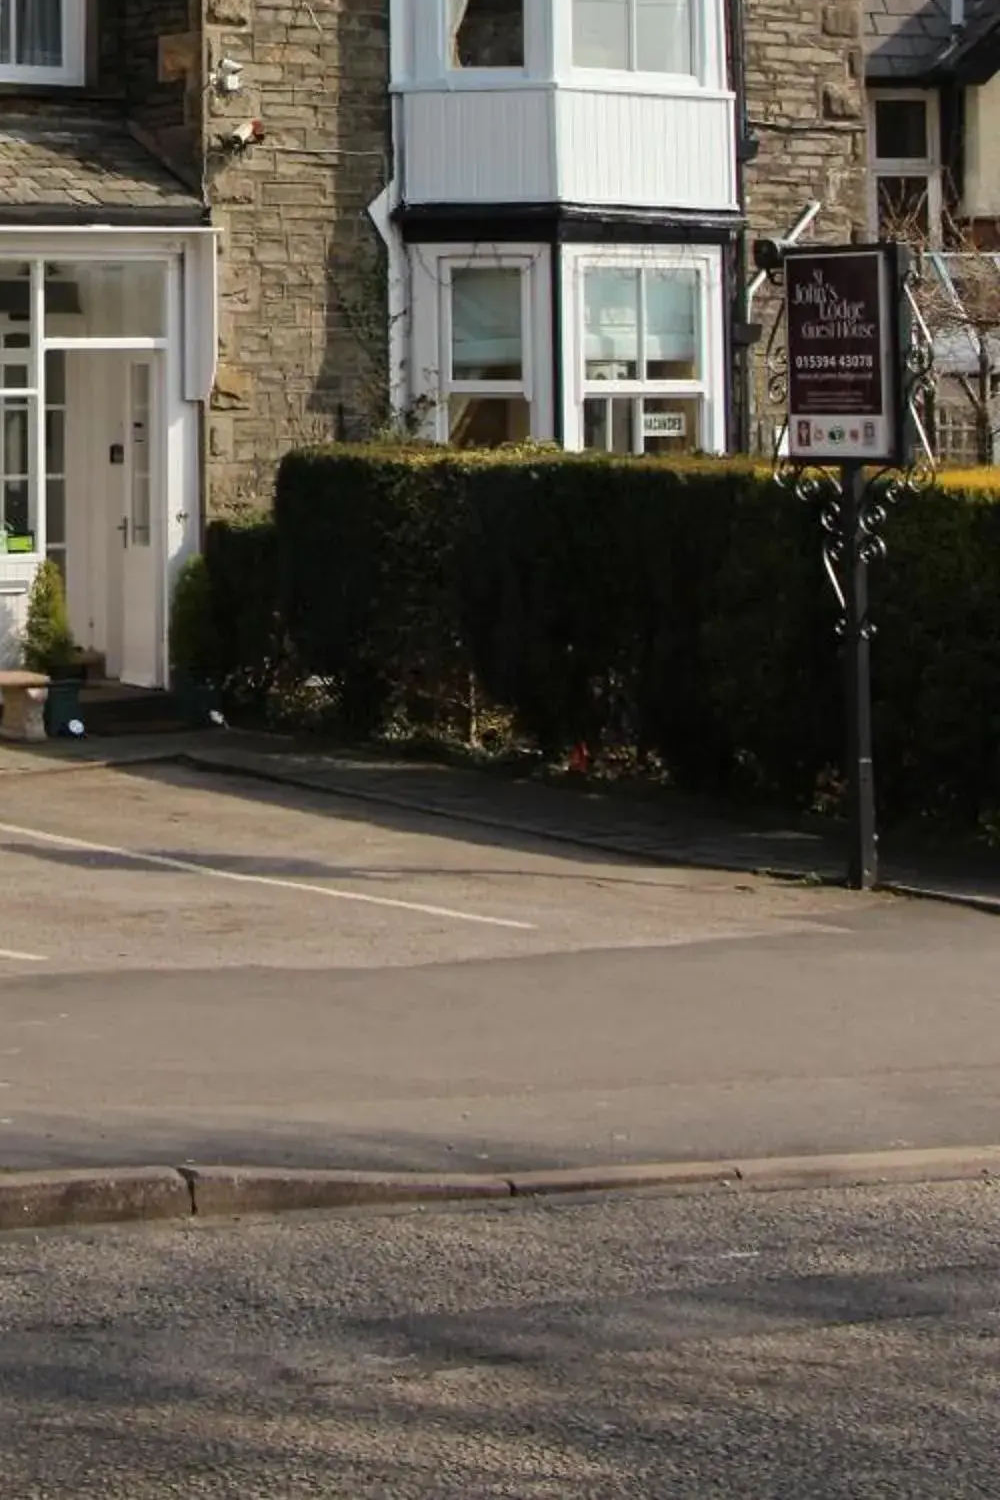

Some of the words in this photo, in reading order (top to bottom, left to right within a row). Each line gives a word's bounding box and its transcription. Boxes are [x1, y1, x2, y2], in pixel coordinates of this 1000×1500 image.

[792, 283, 837, 305] John's
[820, 299, 865, 323] Lodge
[801, 322, 835, 338] Guest
[837, 321, 875, 338] House
[796, 355, 836, 368] 015394
